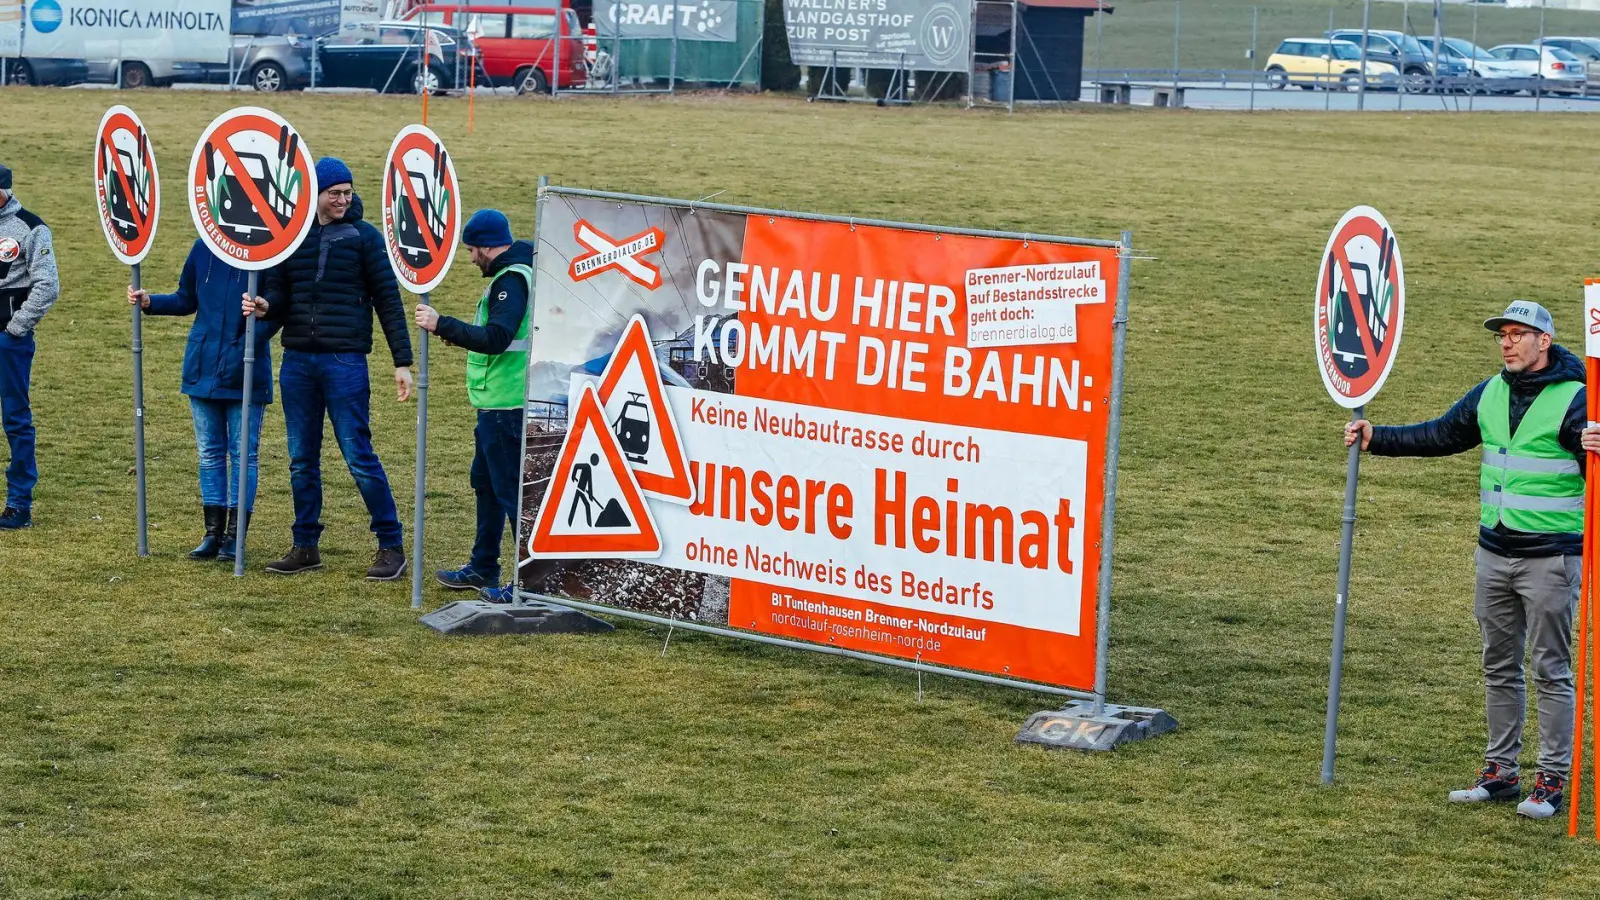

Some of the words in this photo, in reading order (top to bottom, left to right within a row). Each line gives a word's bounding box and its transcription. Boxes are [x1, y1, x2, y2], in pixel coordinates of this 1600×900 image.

[70, 7, 141, 29] KONICA
[146, 11, 224, 31] MINOLTA
[609, 3, 698, 26] CRAFT
[787, 0, 887, 11] WALLNER'S
[787, 11, 914, 28] LANDGASTHOF
[786, 26, 817, 40] ZUR
[824, 28, 871, 42] POST
[931, 25, 953, 48] W
[195, 185, 204, 198] BI
[100, 195, 128, 254] KOLBERMOOR
[198, 202, 249, 260] KOLBERMOOR
[387, 223, 417, 282] KOLBERMOOR
[575, 234, 655, 274] BRENNERDIALOG.DE
[968, 265, 1097, 286] Brenner-Nordzulauf
[696, 258, 840, 322] GENAU
[852, 276, 957, 336] HIER
[970, 291, 990, 304] auf
[993, 284, 1098, 303] Bestandsstrecke
[970, 309, 996, 326] geht
[1000, 306, 1035, 321] doch:
[1320, 305, 1326, 321] BI
[971, 324, 1073, 342] brennerdialog.de
[693, 315, 847, 380] KOMMT
[856, 336, 929, 393] DIE
[943, 346, 1093, 413] BAHN:
[1320, 327, 1351, 395] KOLBERMOOR
[691, 397, 748, 430] Keine
[754, 407, 904, 453] Neubautrasse
[912, 430, 980, 463] durch
[689, 460, 853, 540] unsere
[875, 468, 1075, 575] Heimat
[686, 537, 738, 567] ohne
[745, 544, 846, 586] Nachweis
[854, 564, 892, 594] des
[901, 571, 995, 610] Bedarfs
[771, 592, 782, 606] BI
[784, 594, 862, 621] Tuntenhausen
[865, 608, 987, 642] Brenner-Nordzulauf
[771, 612, 941, 651] nordzulauf-rosenheim-nord.de
